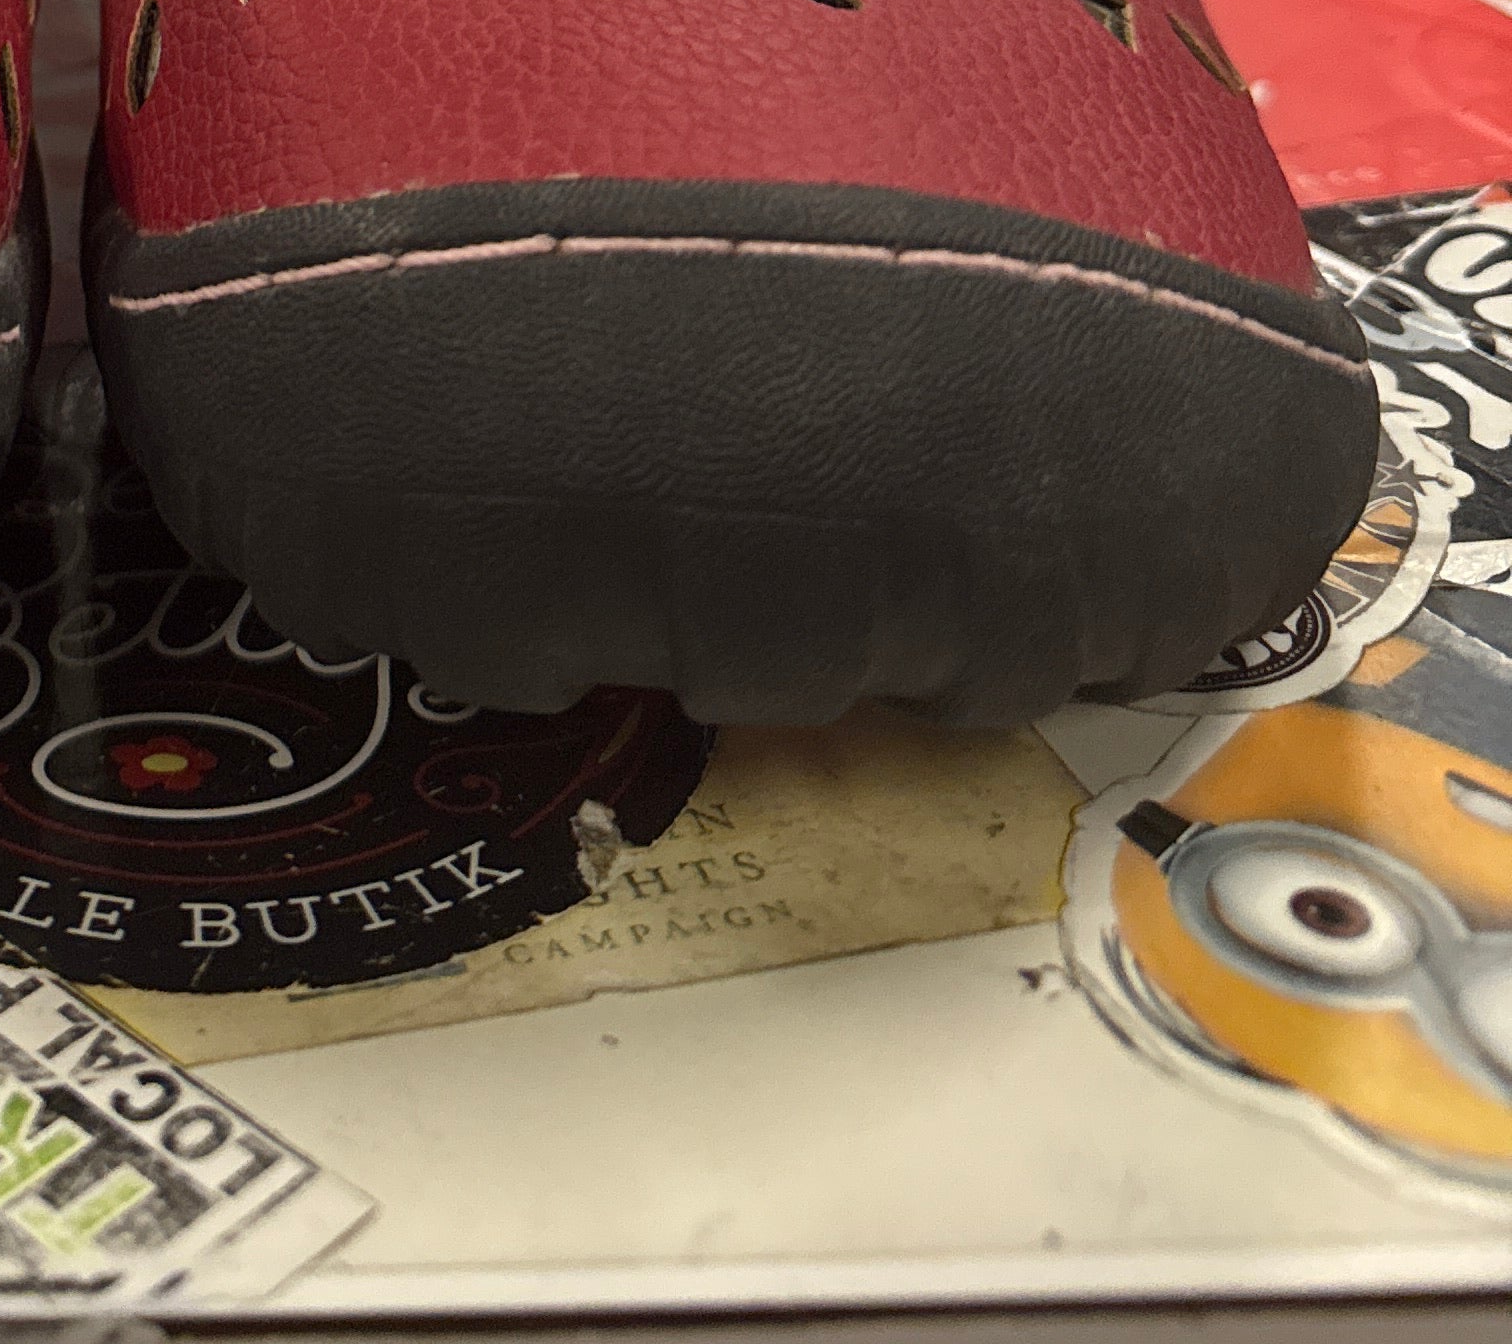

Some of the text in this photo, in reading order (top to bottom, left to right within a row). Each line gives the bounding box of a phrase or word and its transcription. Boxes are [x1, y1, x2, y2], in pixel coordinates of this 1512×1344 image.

[179, 840, 524, 949] BUTIK
[502, 898, 794, 965] CAMPAIGN
[36, 1001, 285, 1197] LOCAL
